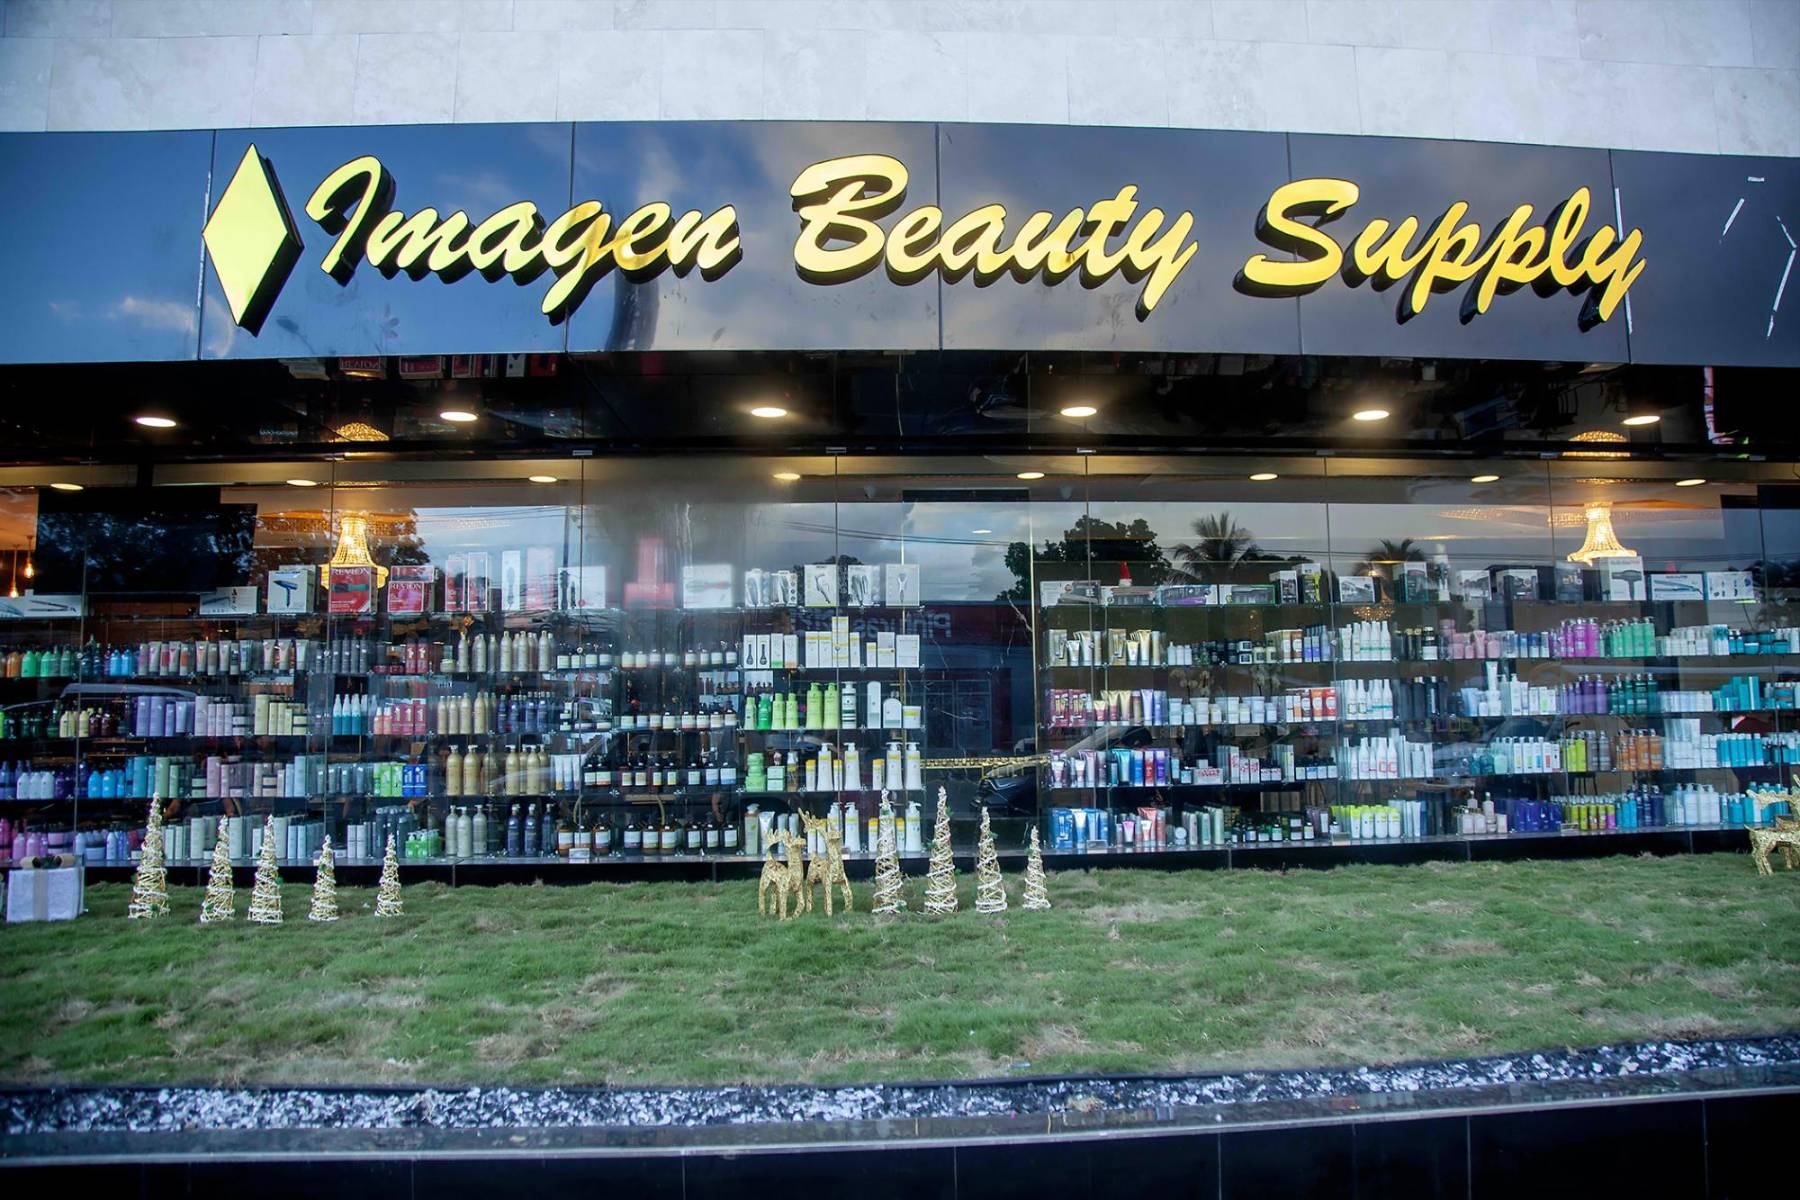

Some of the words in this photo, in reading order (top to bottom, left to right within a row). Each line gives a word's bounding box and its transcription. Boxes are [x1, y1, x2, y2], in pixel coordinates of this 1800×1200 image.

[305, 155, 741, 317] Imagen
[792, 154, 1199, 313] Beauty
[1240, 178, 1646, 322] Supply
[331, 567, 370, 577] REVLON
